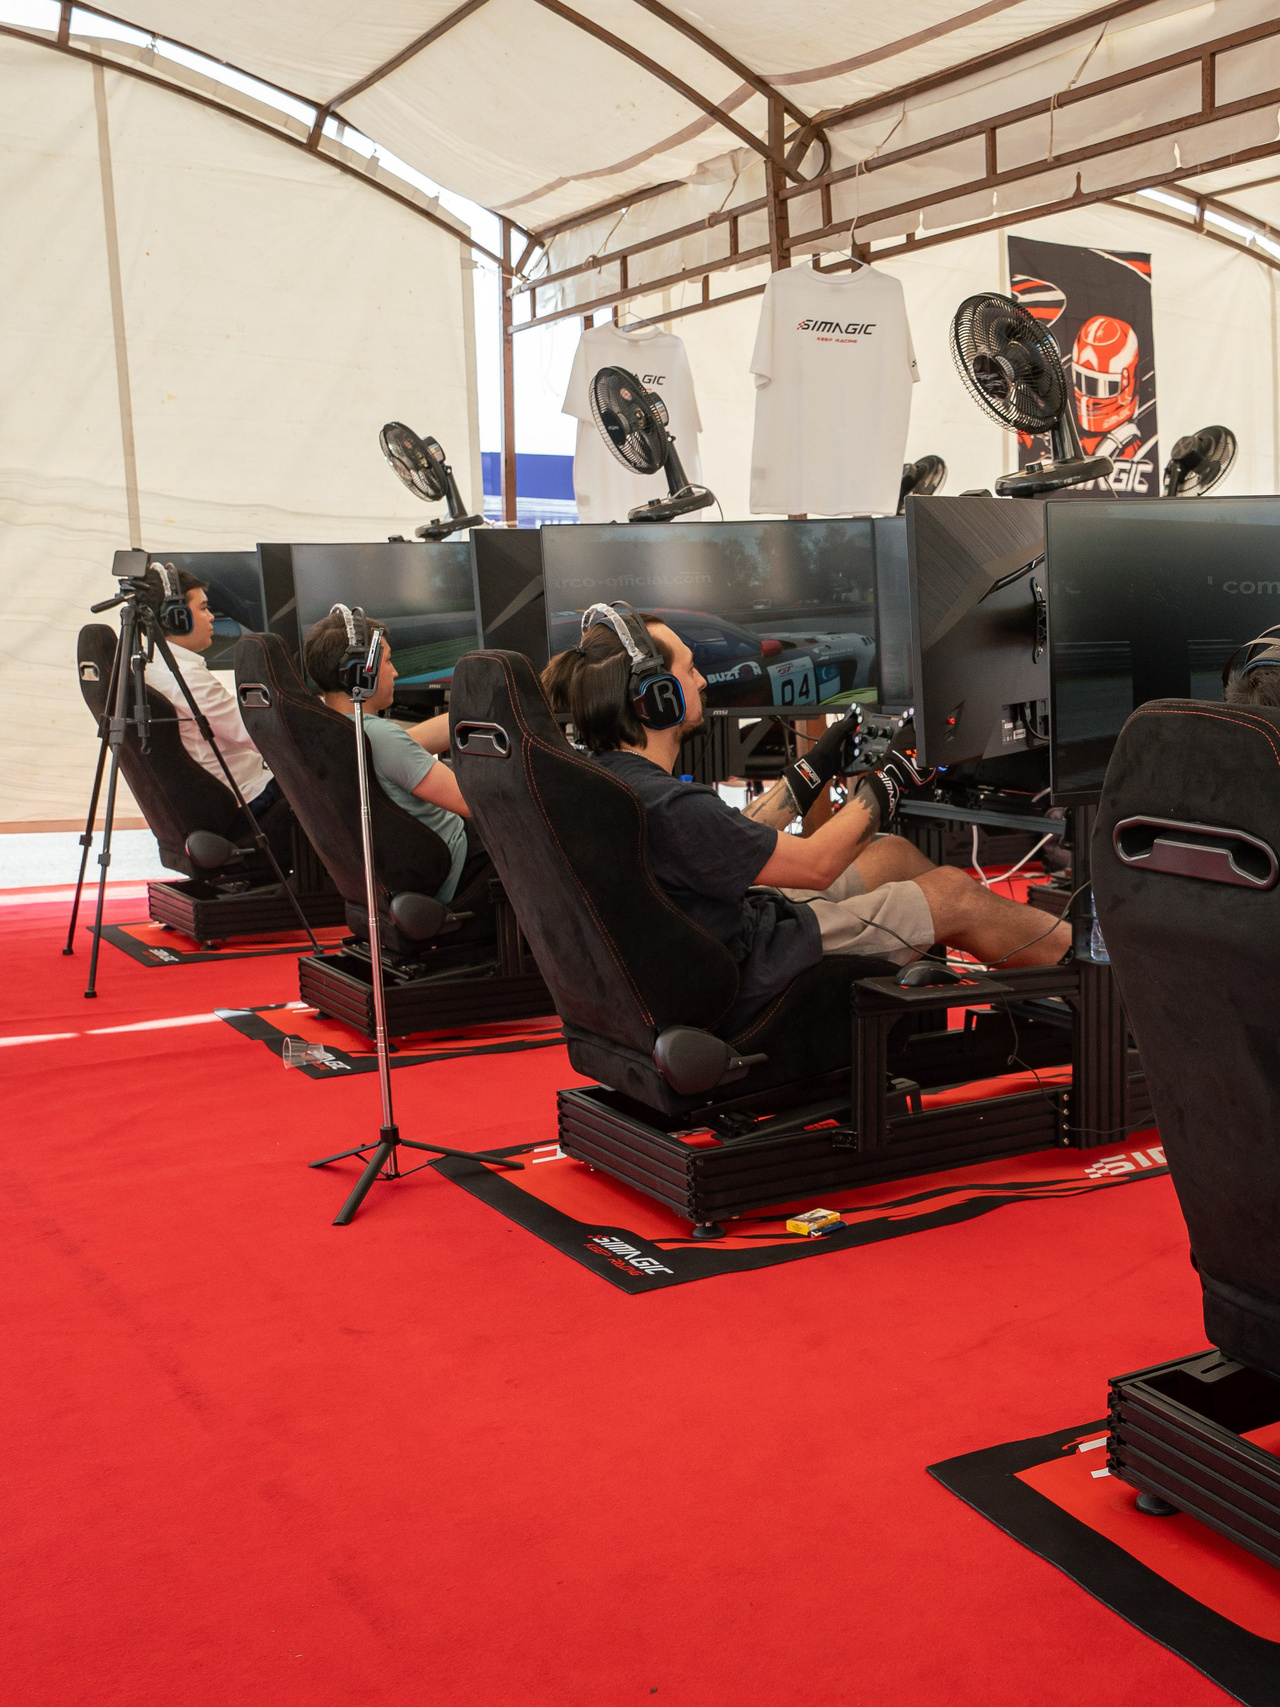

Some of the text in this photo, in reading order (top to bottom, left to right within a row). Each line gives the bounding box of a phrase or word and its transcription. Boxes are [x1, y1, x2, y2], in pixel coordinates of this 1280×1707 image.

[796, 319, 877, 335] SIMAGIC
[781, 673, 810, 707] 04
[587, 1234, 675, 1275] SIMAGIC
